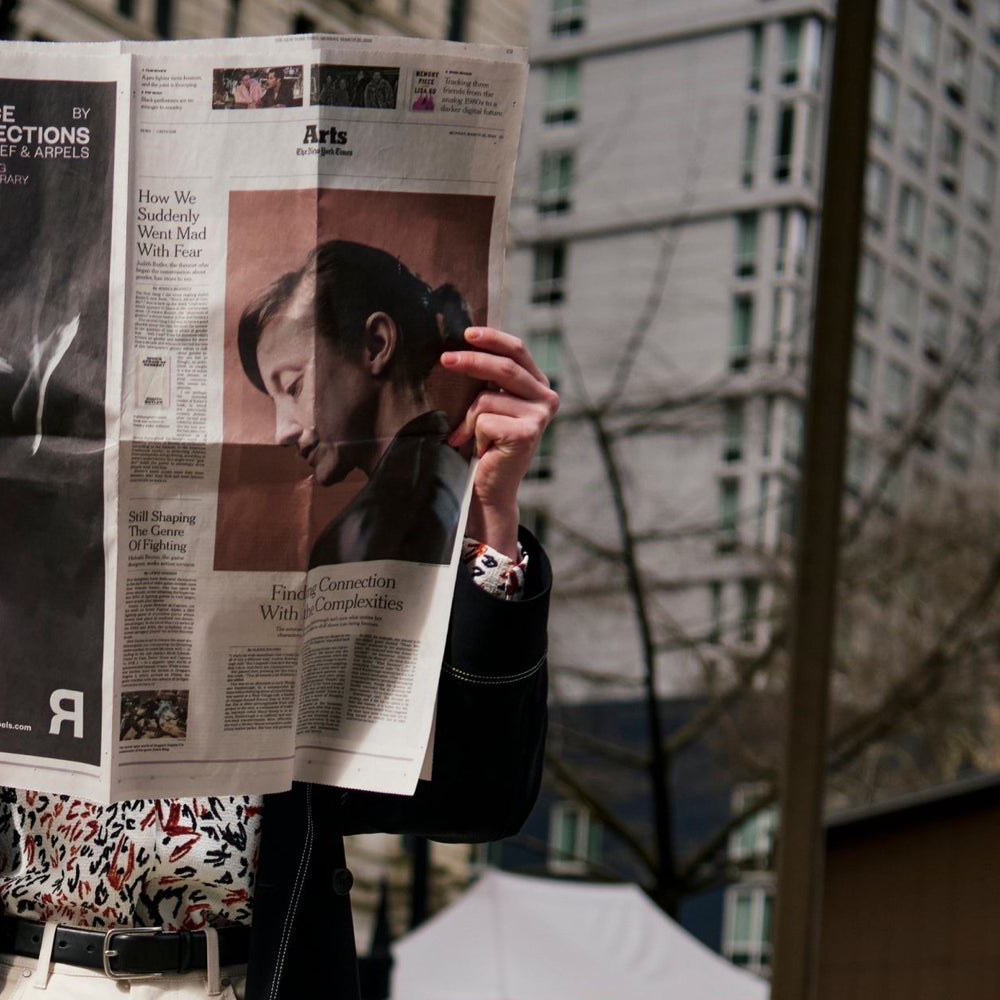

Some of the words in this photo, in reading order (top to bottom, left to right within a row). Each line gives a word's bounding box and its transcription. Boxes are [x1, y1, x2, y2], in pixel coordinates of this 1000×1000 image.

[72, 107, 91, 119] BY
[303, 124, 348, 145] Arts
[20, 146, 31, 158] &
[34, 146, 90, 158] ARPELS
[138, 189, 170, 204] How
[174, 190, 197, 205] We
[137, 207, 200, 225] Suddenly
[137, 224, 171, 240] Went
[176, 226, 207, 240] Mad
[137, 241, 170, 257] With
[174, 243, 203, 258] Fear
[128, 510, 149, 523] Still
[151, 510, 197, 526] Shaping
[128, 524, 149, 537] The
[150, 524, 185, 537] Genre
[128, 539, 142, 551] Of
[143, 538, 188, 553] Fighting
[318, 573, 397, 592] Connection
[260, 604, 299, 621] With
[303, 605, 315, 620] the
[315, 594, 404, 613] Complexities
